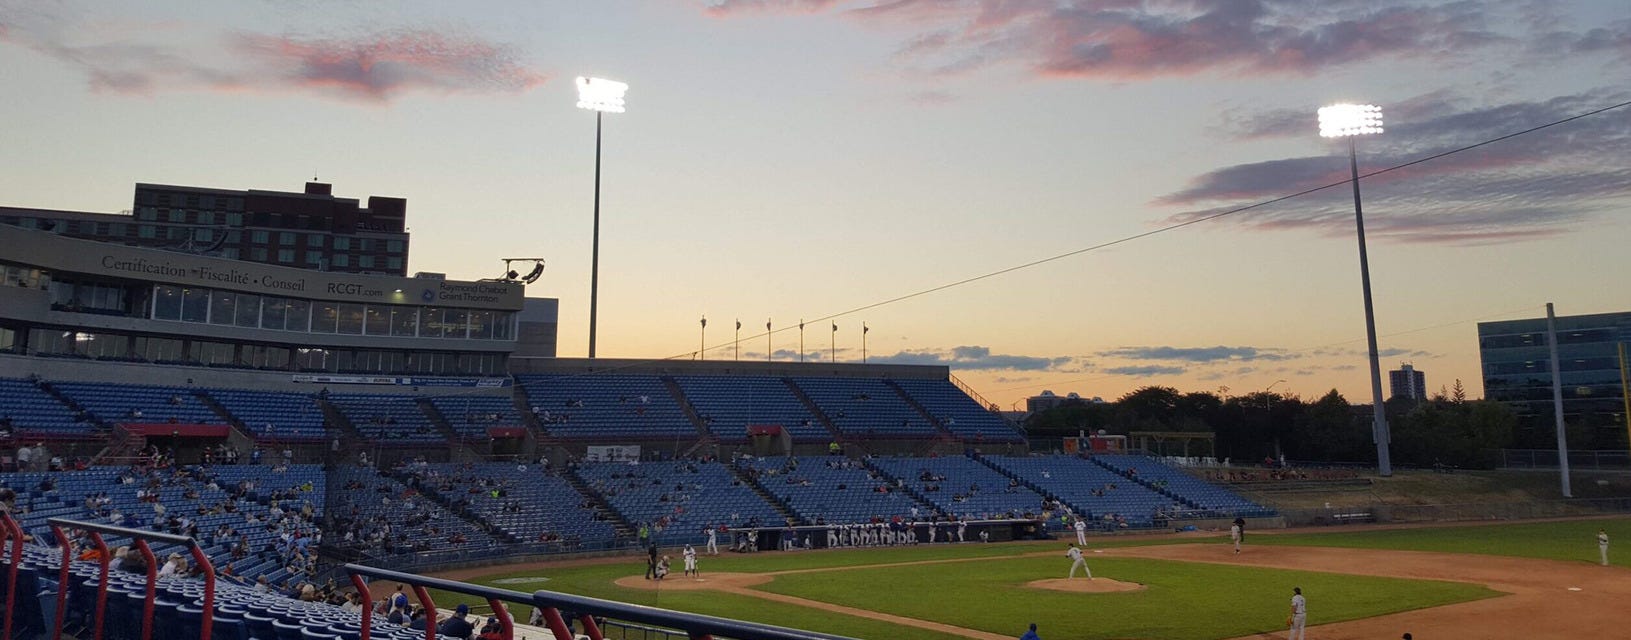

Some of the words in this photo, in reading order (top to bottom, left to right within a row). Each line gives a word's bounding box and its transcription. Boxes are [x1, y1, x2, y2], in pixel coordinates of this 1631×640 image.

[101, 255, 187, 277] Certification
[199, 266, 249, 285] Fiscalité
[262, 275, 306, 292] Conseil
[327, 282, 383, 298] RCGT.com
[440, 282, 478, 293] Raymond
